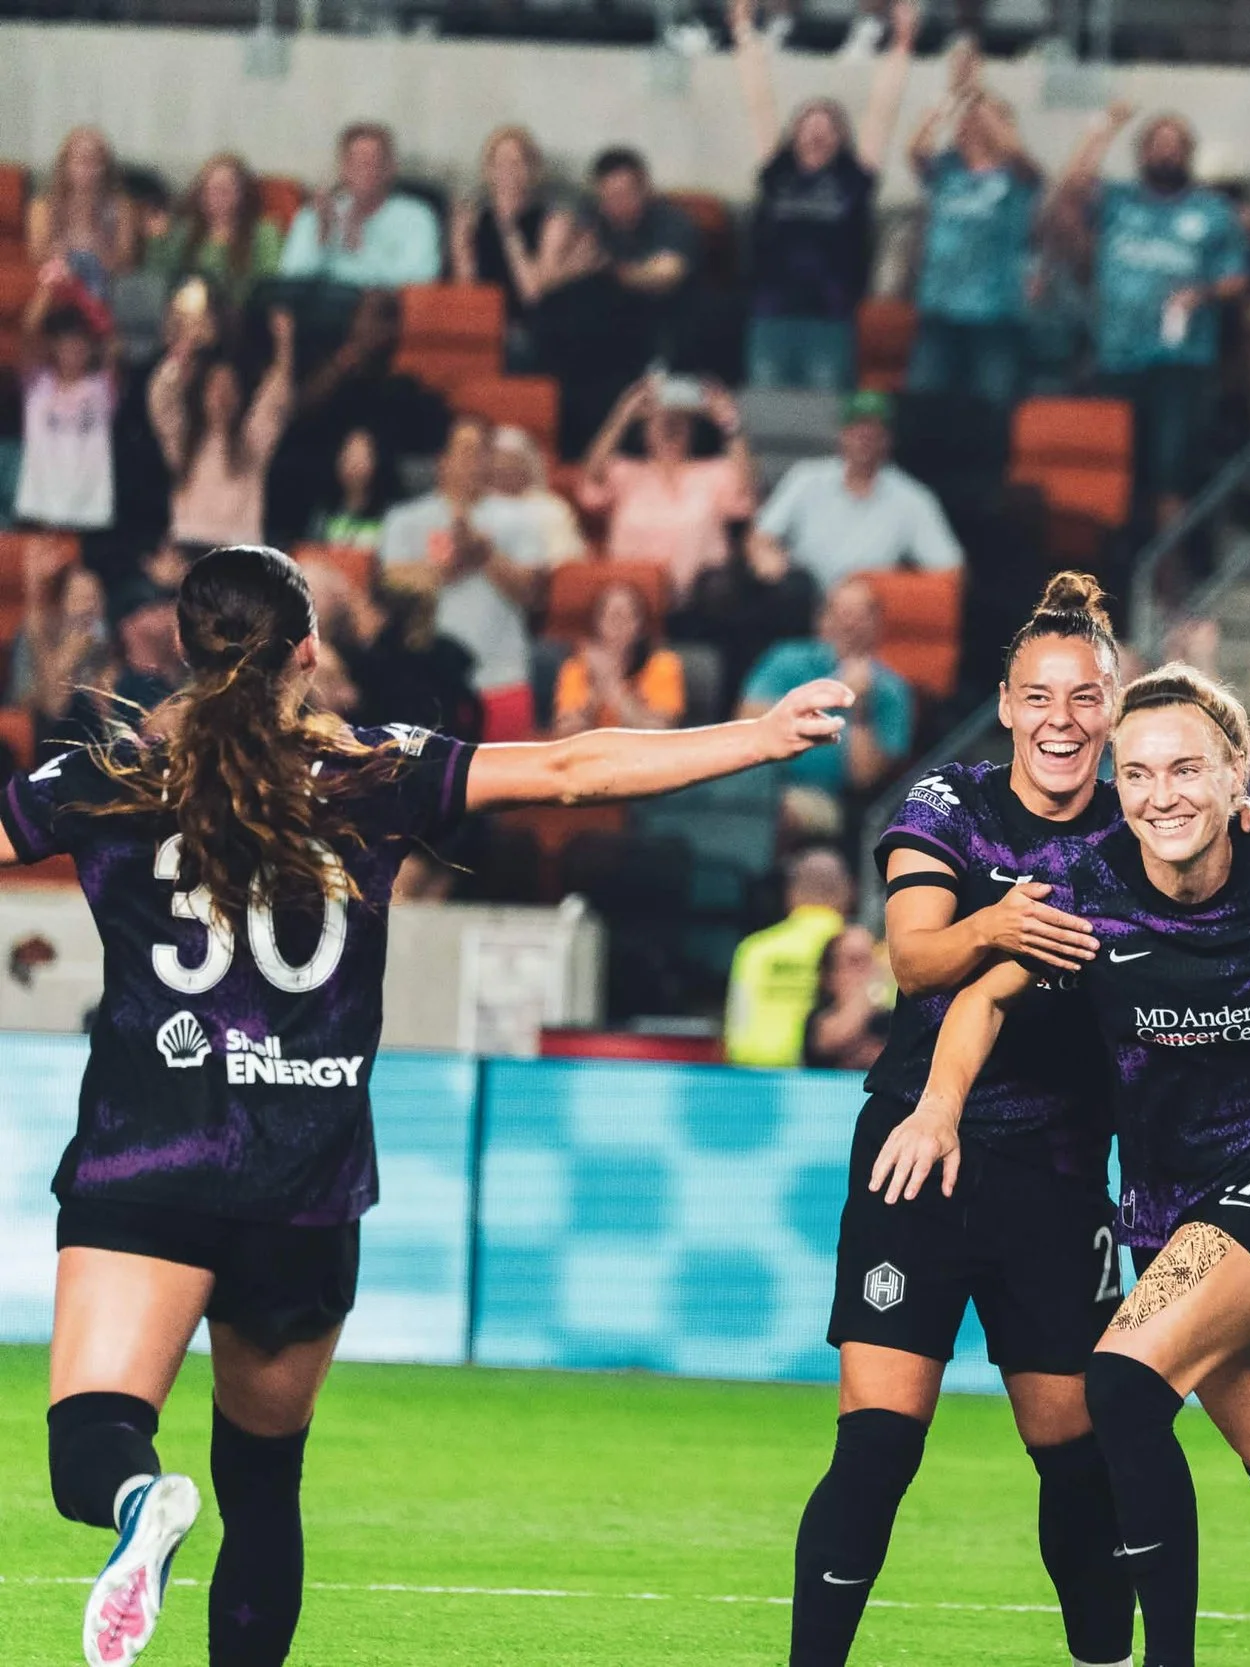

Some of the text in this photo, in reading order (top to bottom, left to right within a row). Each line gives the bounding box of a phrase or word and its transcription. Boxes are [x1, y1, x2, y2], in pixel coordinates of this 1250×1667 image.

[151, 832, 348, 994] 30
[1134, 1007, 1179, 1028] MD
[1136, 1027, 1220, 1047] Cancer
[226, 1054, 364, 1087] ENERGY
